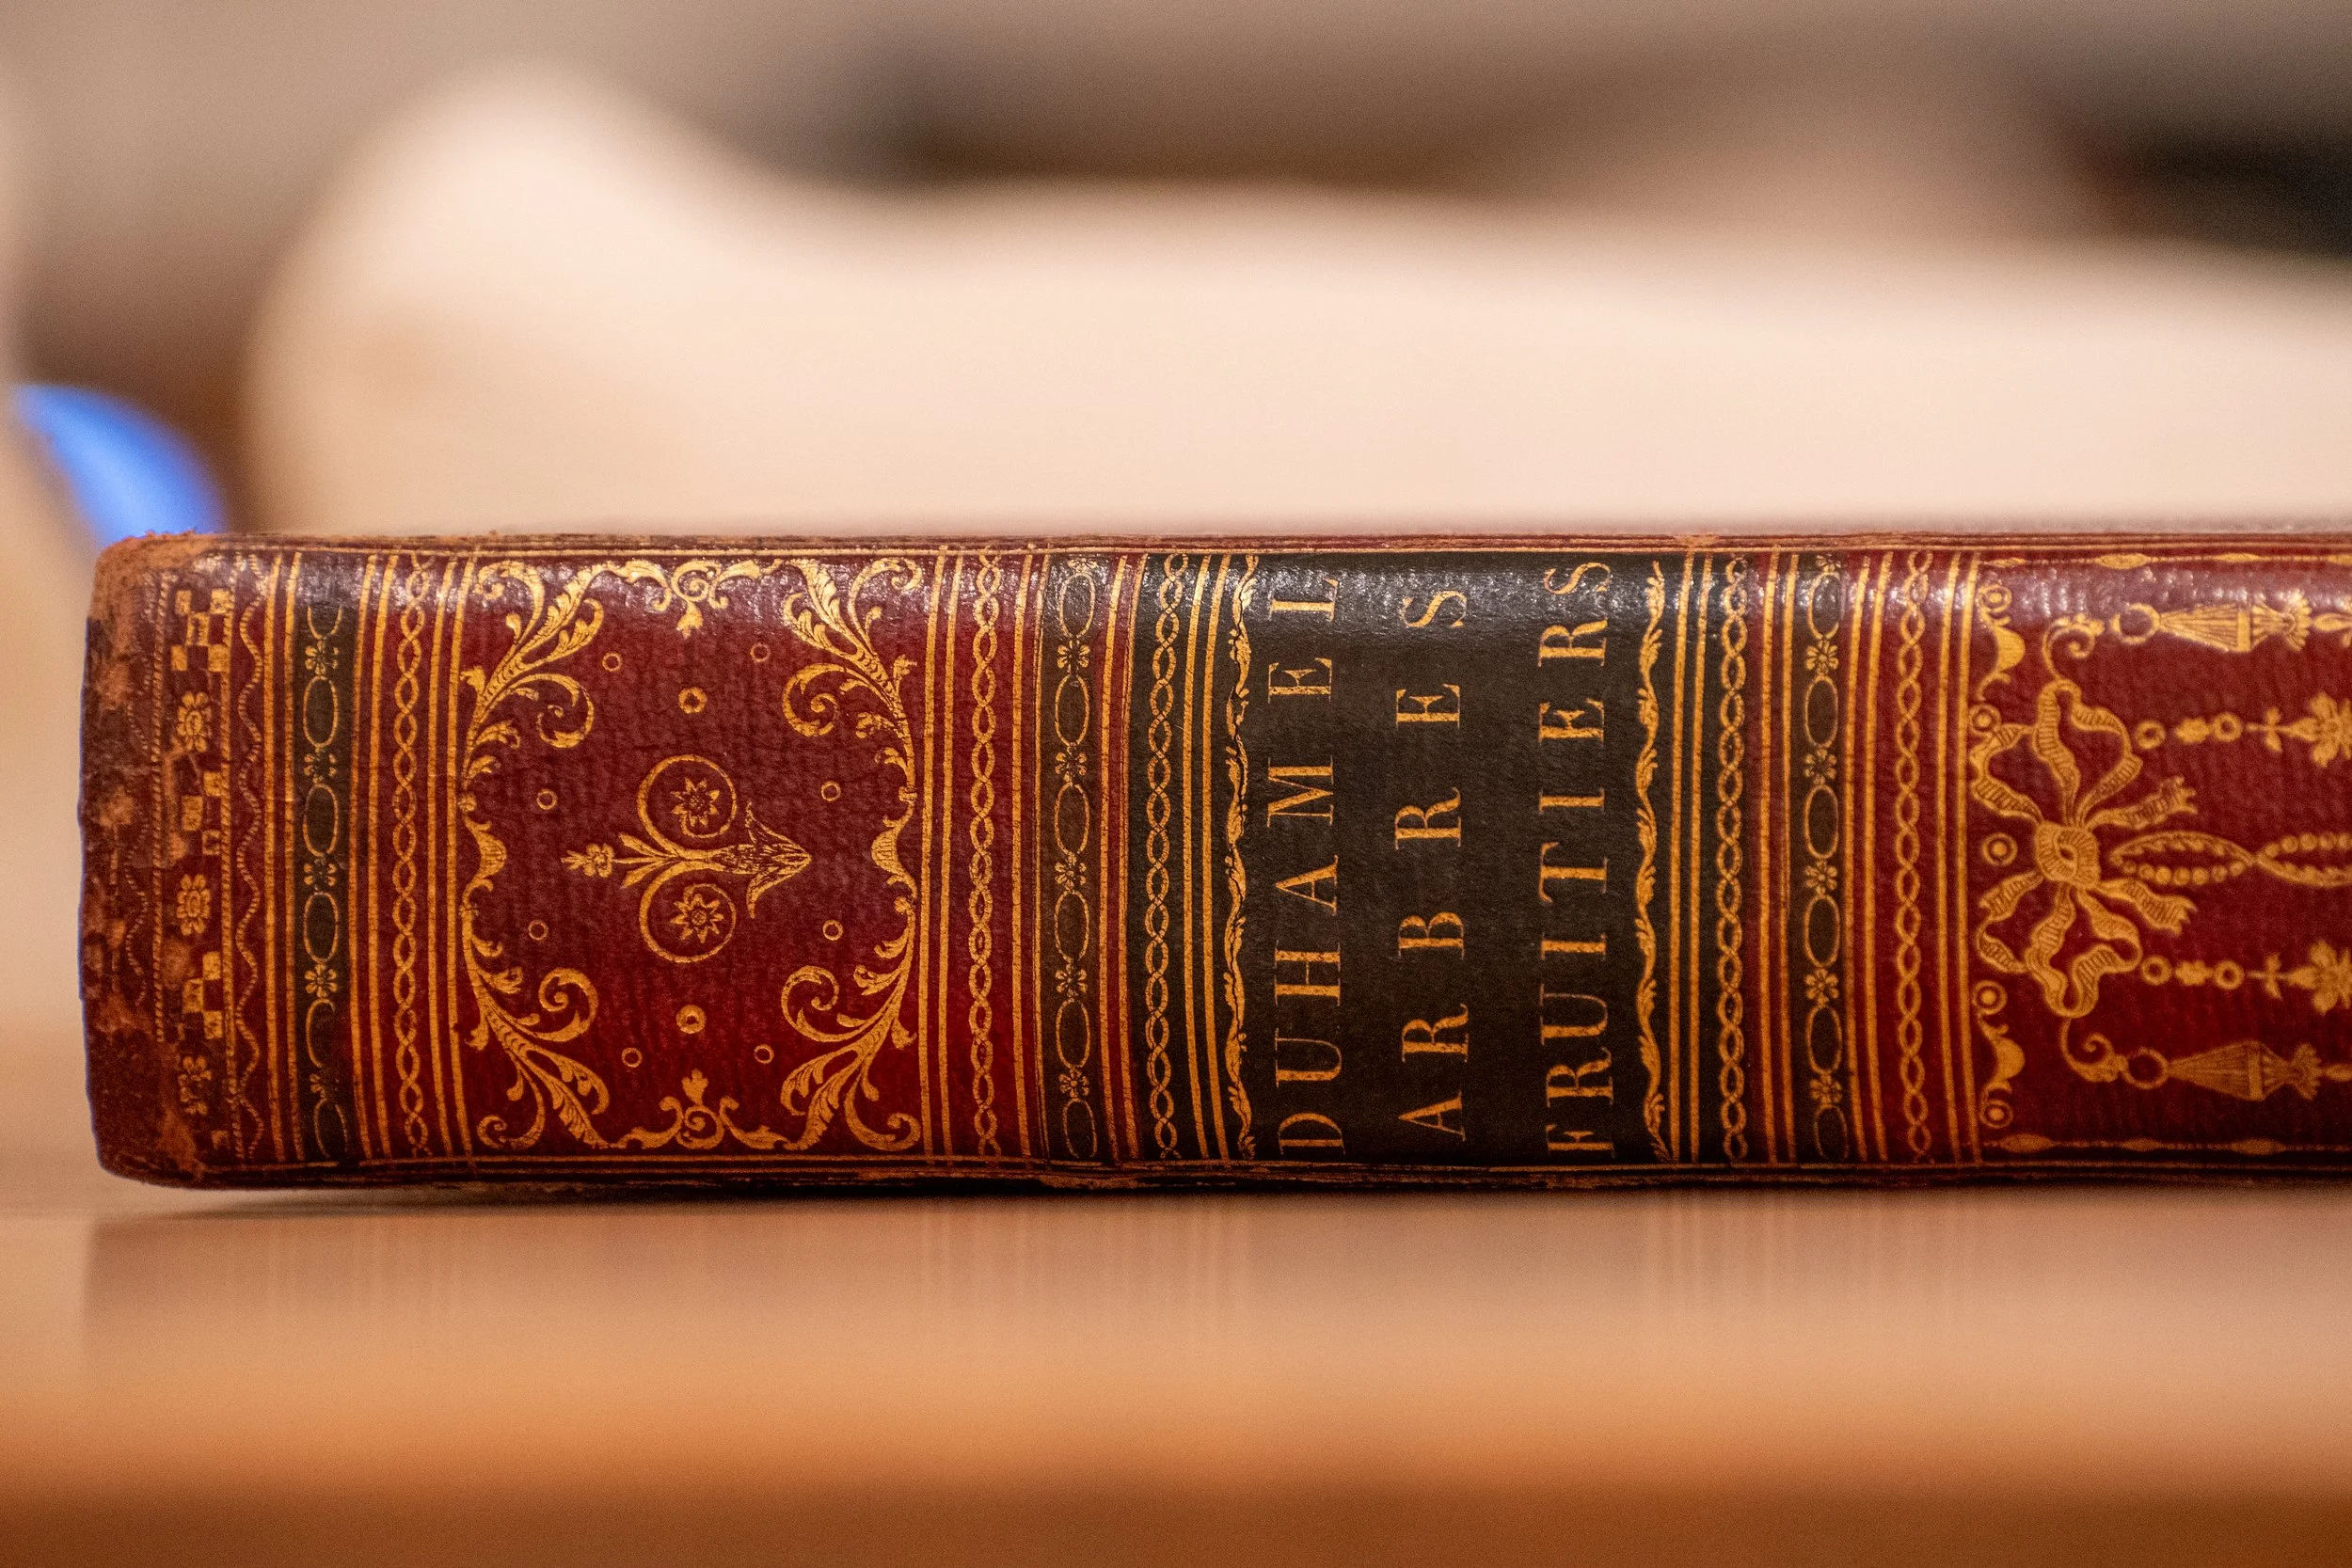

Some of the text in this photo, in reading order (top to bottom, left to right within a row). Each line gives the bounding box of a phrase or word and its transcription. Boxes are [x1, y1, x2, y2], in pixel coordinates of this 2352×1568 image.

[1267, 577, 1346, 1155] DUHAMEL
[1394, 590, 1470, 1142] ARBRES
[1538, 562, 1615, 1159] FRUITIERS
